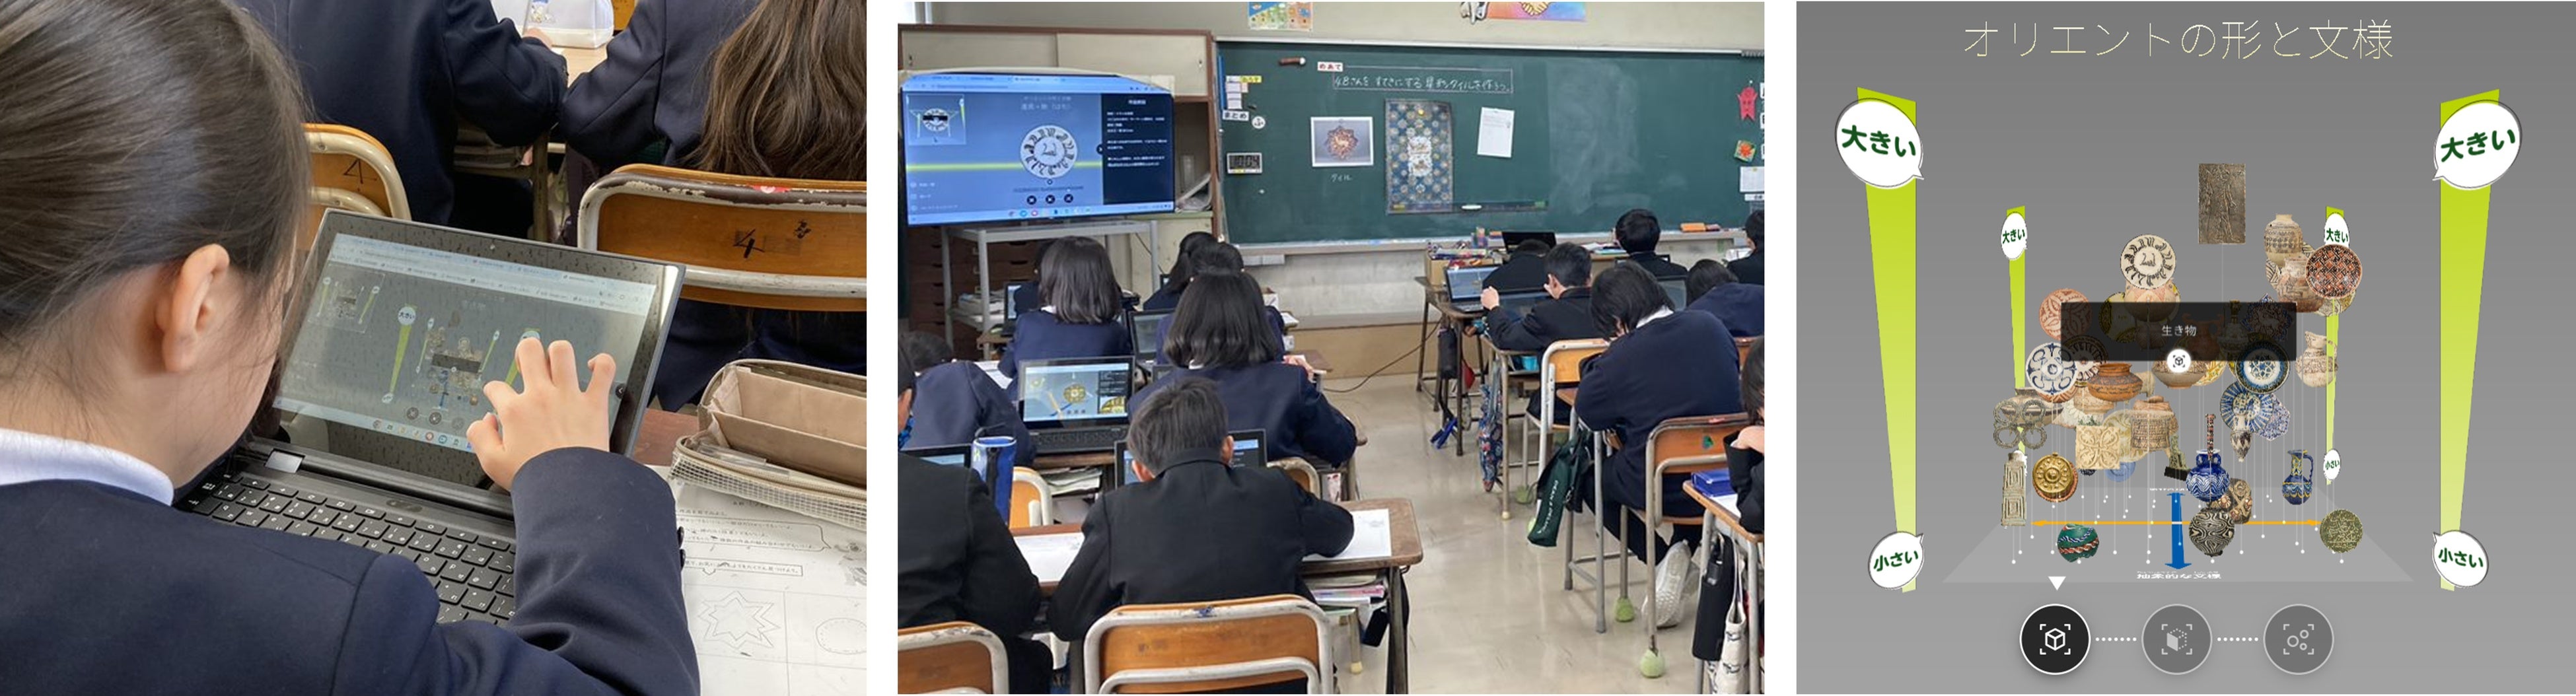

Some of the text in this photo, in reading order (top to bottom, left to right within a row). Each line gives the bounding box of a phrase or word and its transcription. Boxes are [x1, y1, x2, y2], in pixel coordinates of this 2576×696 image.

[1964, 18, 2394, 60] オリエントの形と文様
[1842, 124, 1916, 157] 大きい
[2441, 129, 2515, 162] 大きい
[733, 228, 765, 259] 4
[2002, 228, 2025, 244] 大きい
[2326, 228, 2349, 243] 大きい
[2161, 324, 2197, 337] 生き物
[2325, 460, 2340, 470] 小さい
[1873, 550, 1919, 572] 小さい
[2438, 547, 2484, 568] 小さい
